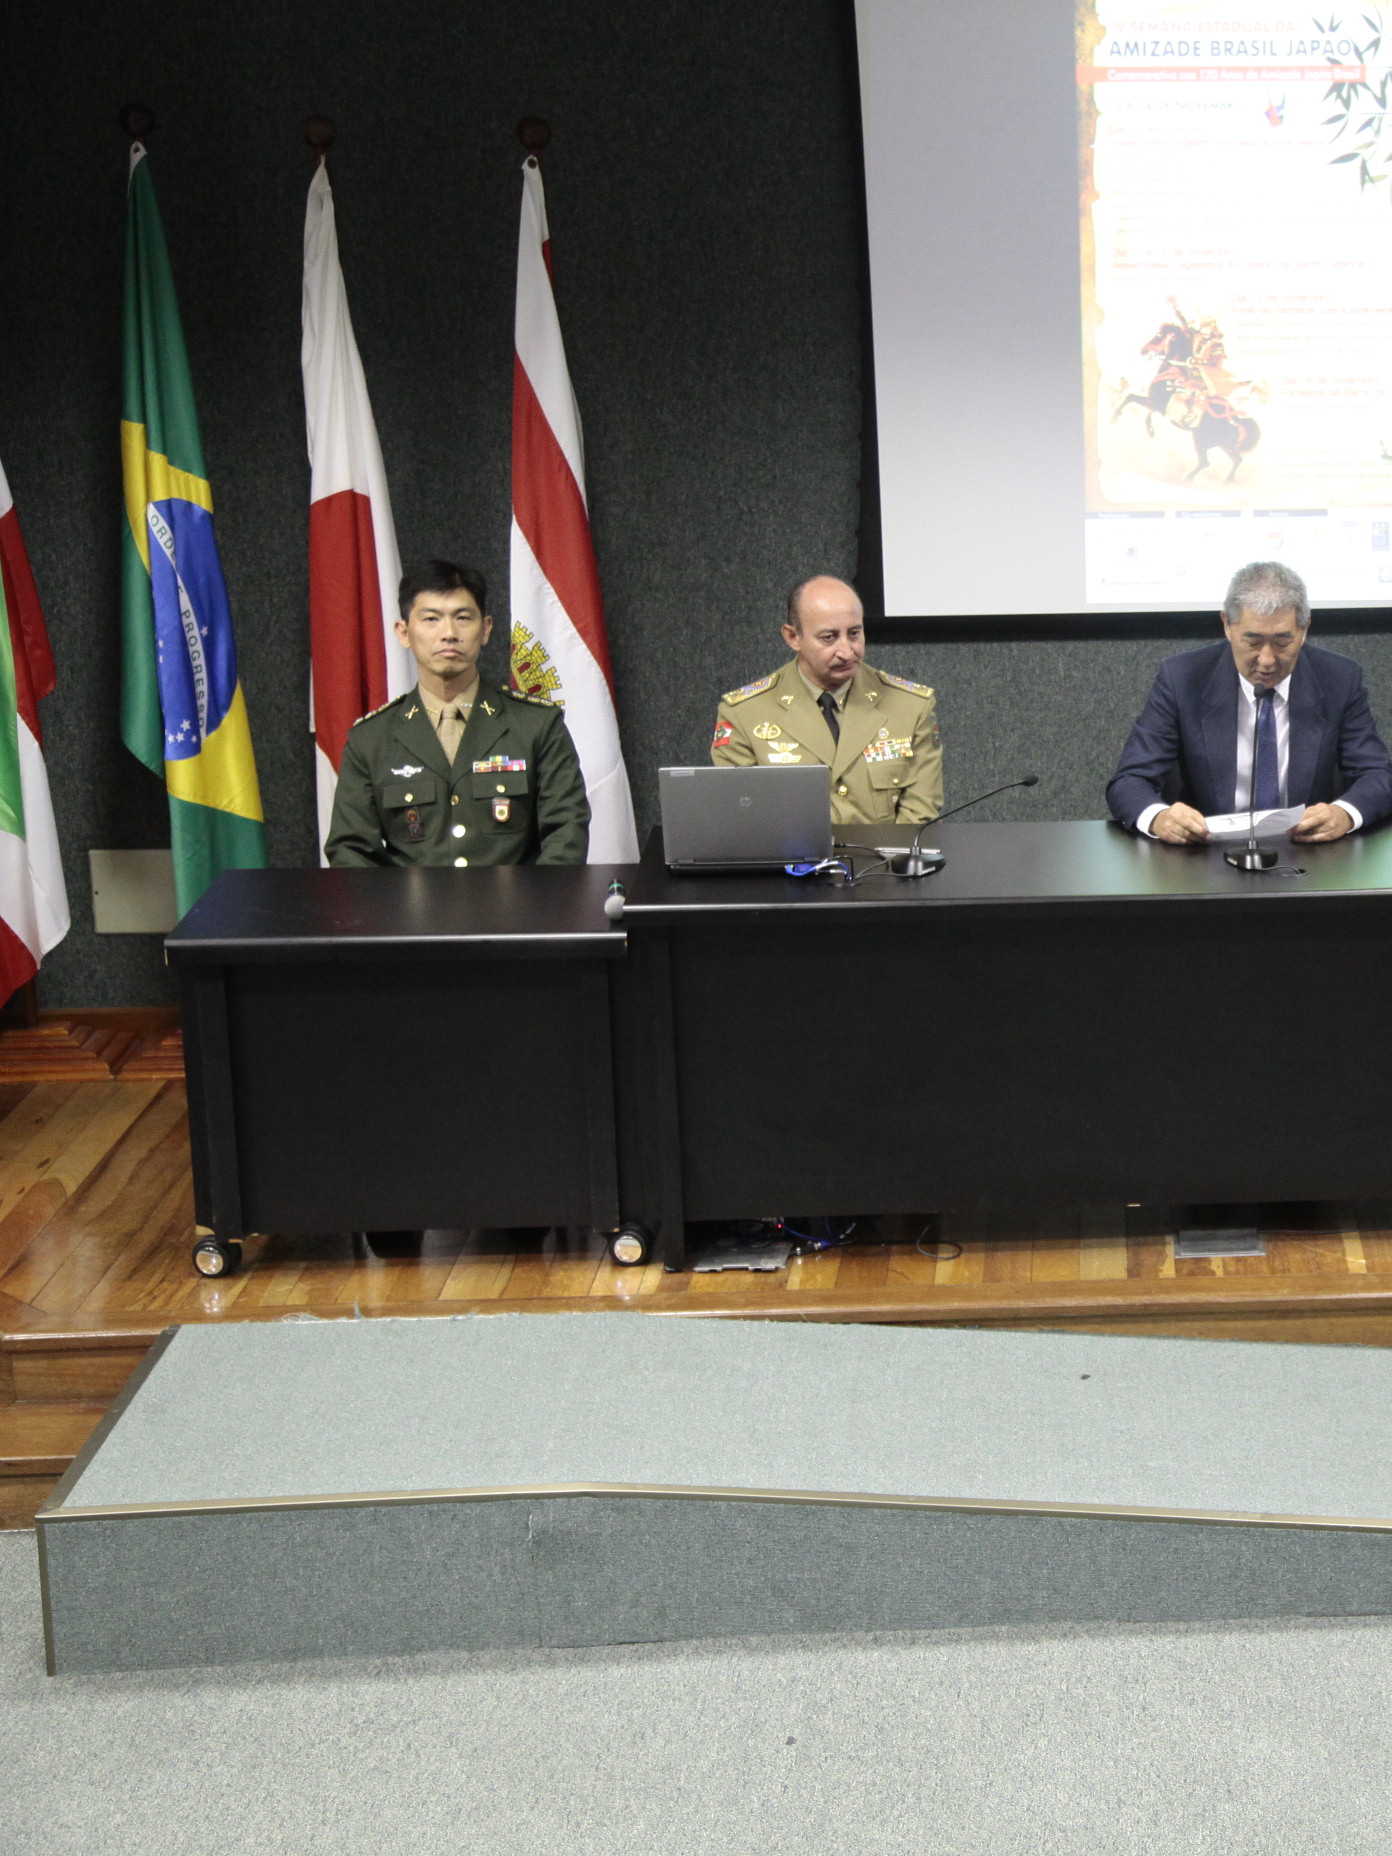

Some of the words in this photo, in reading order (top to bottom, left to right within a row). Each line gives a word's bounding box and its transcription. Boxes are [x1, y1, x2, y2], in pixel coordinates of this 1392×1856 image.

[1131, 21, 1192, 33] SEMANA
[1198, 20, 1270, 33] ESTADUAL
[1276, 20, 1296, 32] DA
[1109, 39, 1202, 57] AMIZADE
[1210, 39, 1278, 57] BRASIL
[1333, 68, 1361, 80] Brasil
[181, 608, 205, 729] PROGRESSO
